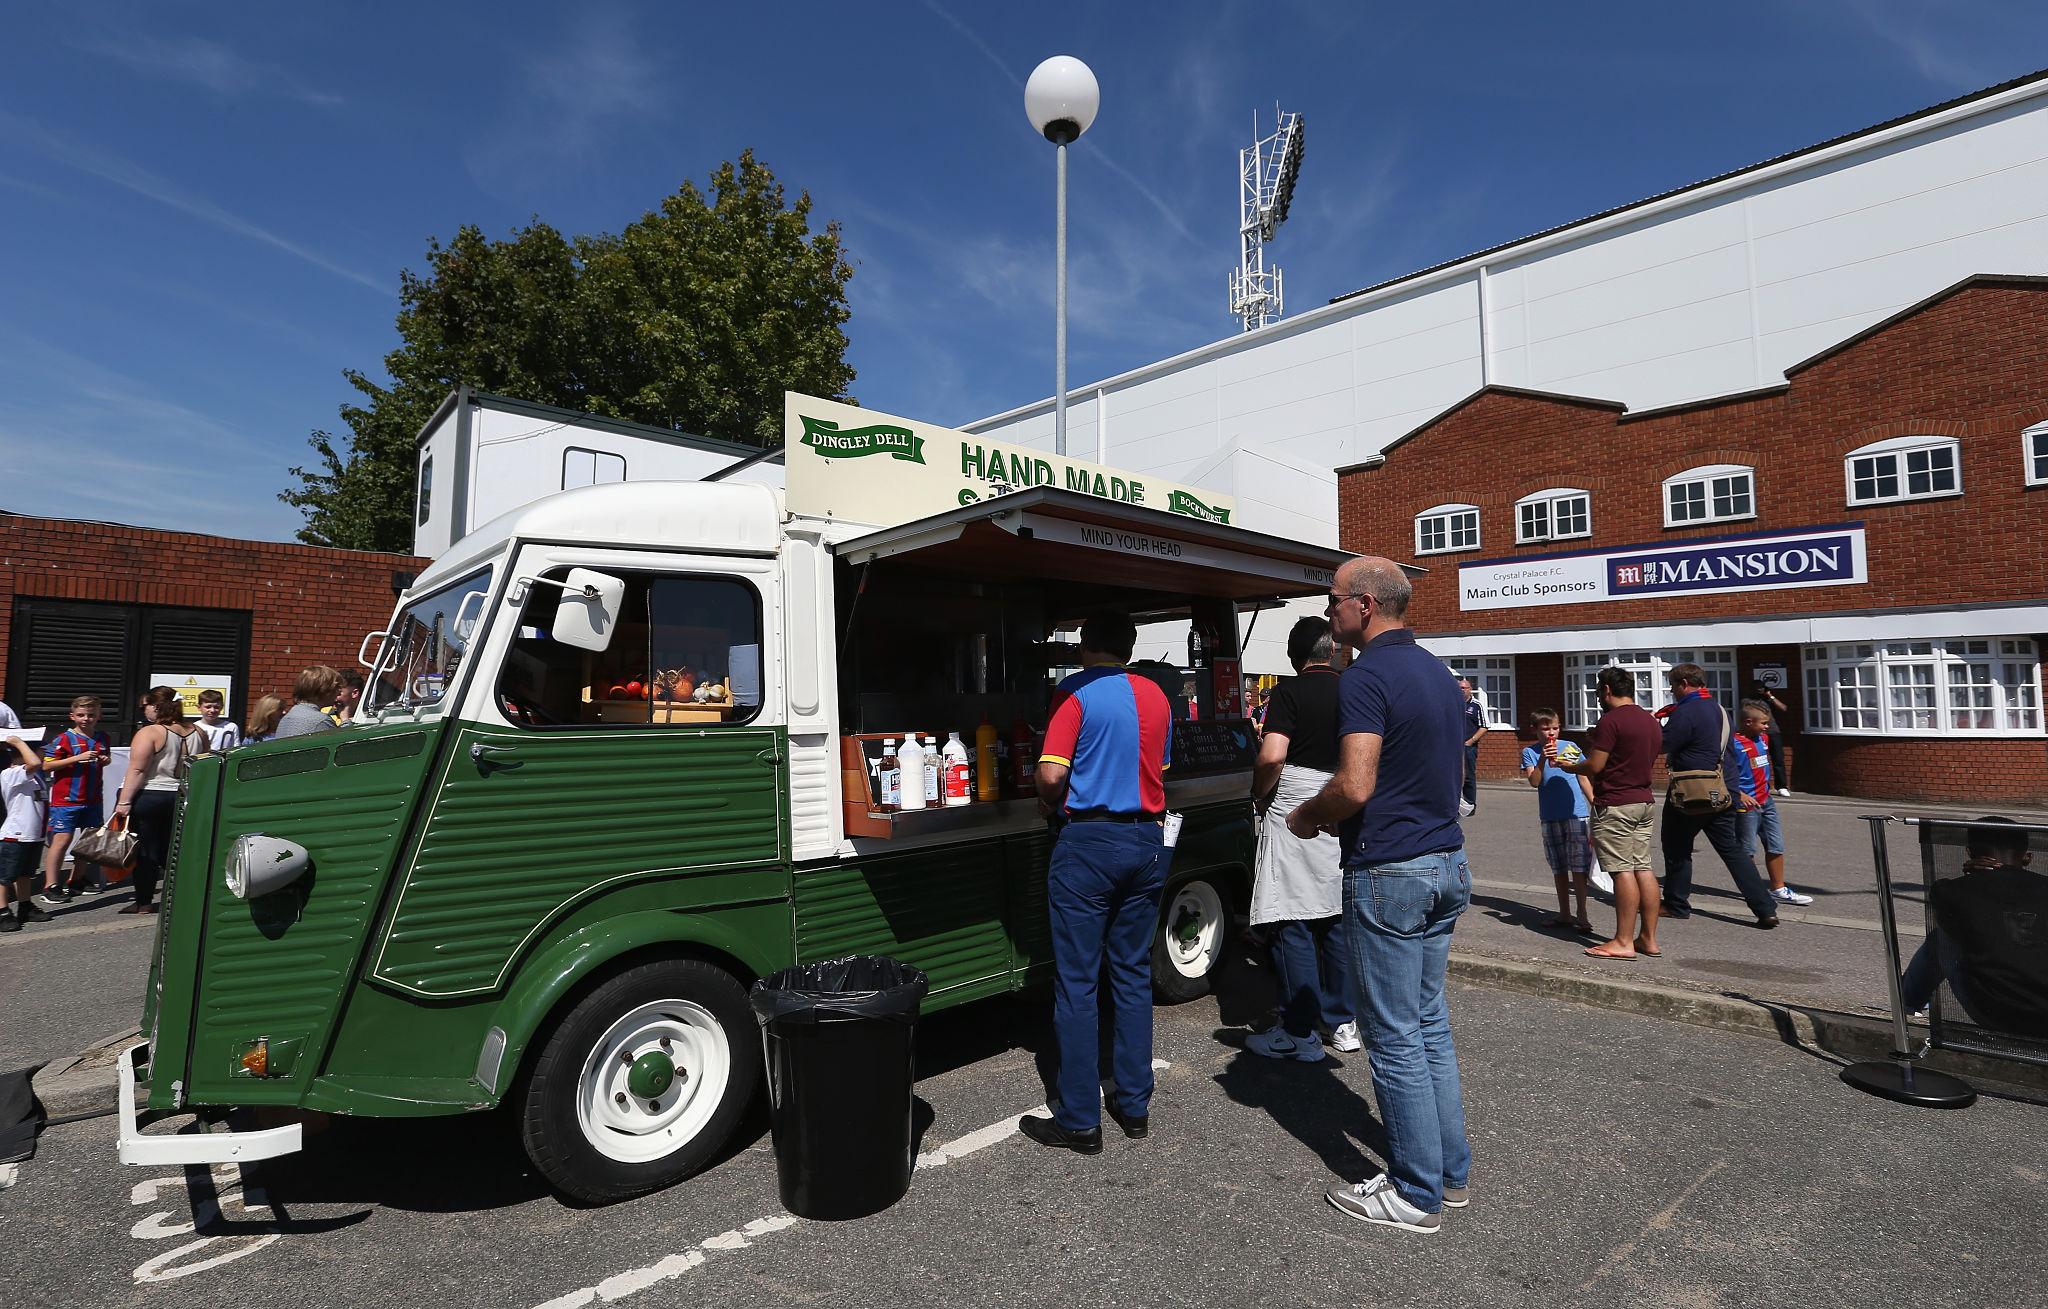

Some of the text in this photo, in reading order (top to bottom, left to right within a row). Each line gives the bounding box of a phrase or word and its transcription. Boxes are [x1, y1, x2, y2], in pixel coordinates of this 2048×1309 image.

[811, 432, 909, 449] DINGLEY DELL
[961, 441, 1145, 505] HAND MADE
[1180, 496, 1222, 523] BOCKWURST
[1080, 527, 1182, 558] MIND YOUR HEAD
[1303, 567, 1323, 582] MIND
[1493, 567, 1564, 581] Crystal Palace F.C.
[1659, 546, 1841, 584] MANSION
[1466, 581, 1596, 600] Main Club Sponsors
